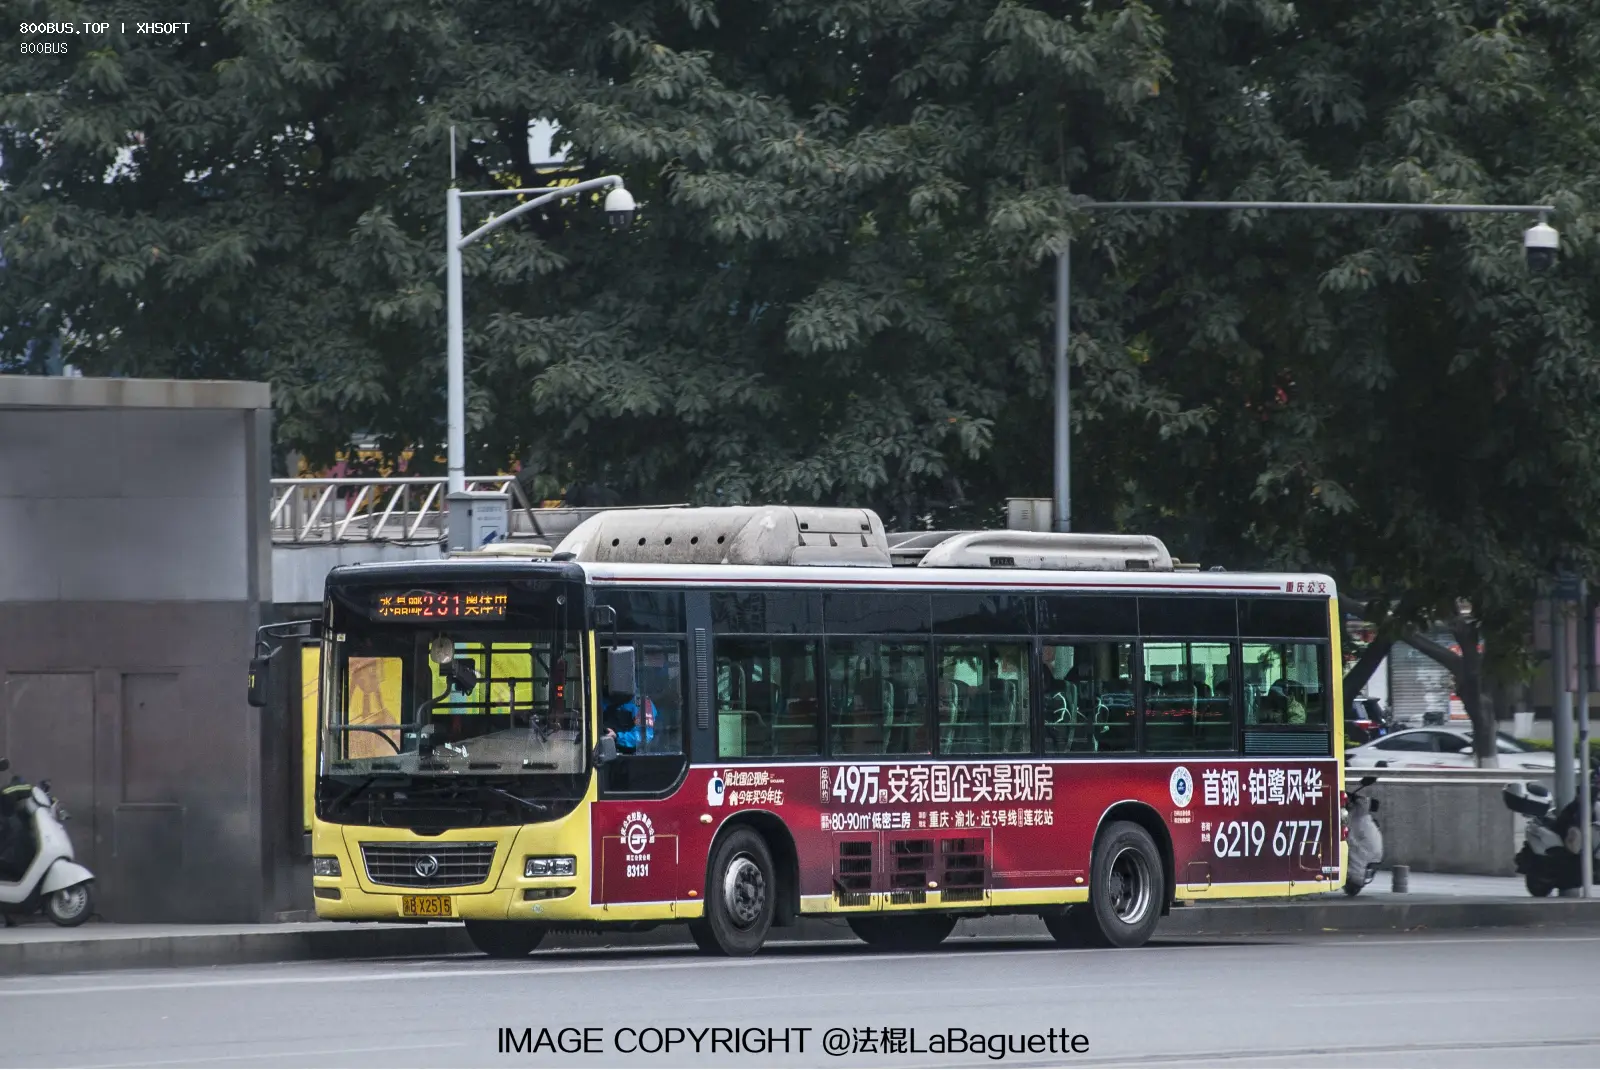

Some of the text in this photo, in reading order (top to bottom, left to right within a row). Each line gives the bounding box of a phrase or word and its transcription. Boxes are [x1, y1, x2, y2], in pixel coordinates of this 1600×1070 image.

[1285, 581, 1327, 593] 重庆公交
[832, 765, 880, 805] 49万
[887, 763, 1053, 803] 安家国企实景现房
[1201, 767, 1323, 806] 首钢·铂鹭风华
[1213, 820, 1323, 858] 6219 6777
[626, 864, 649, 878] 83131
